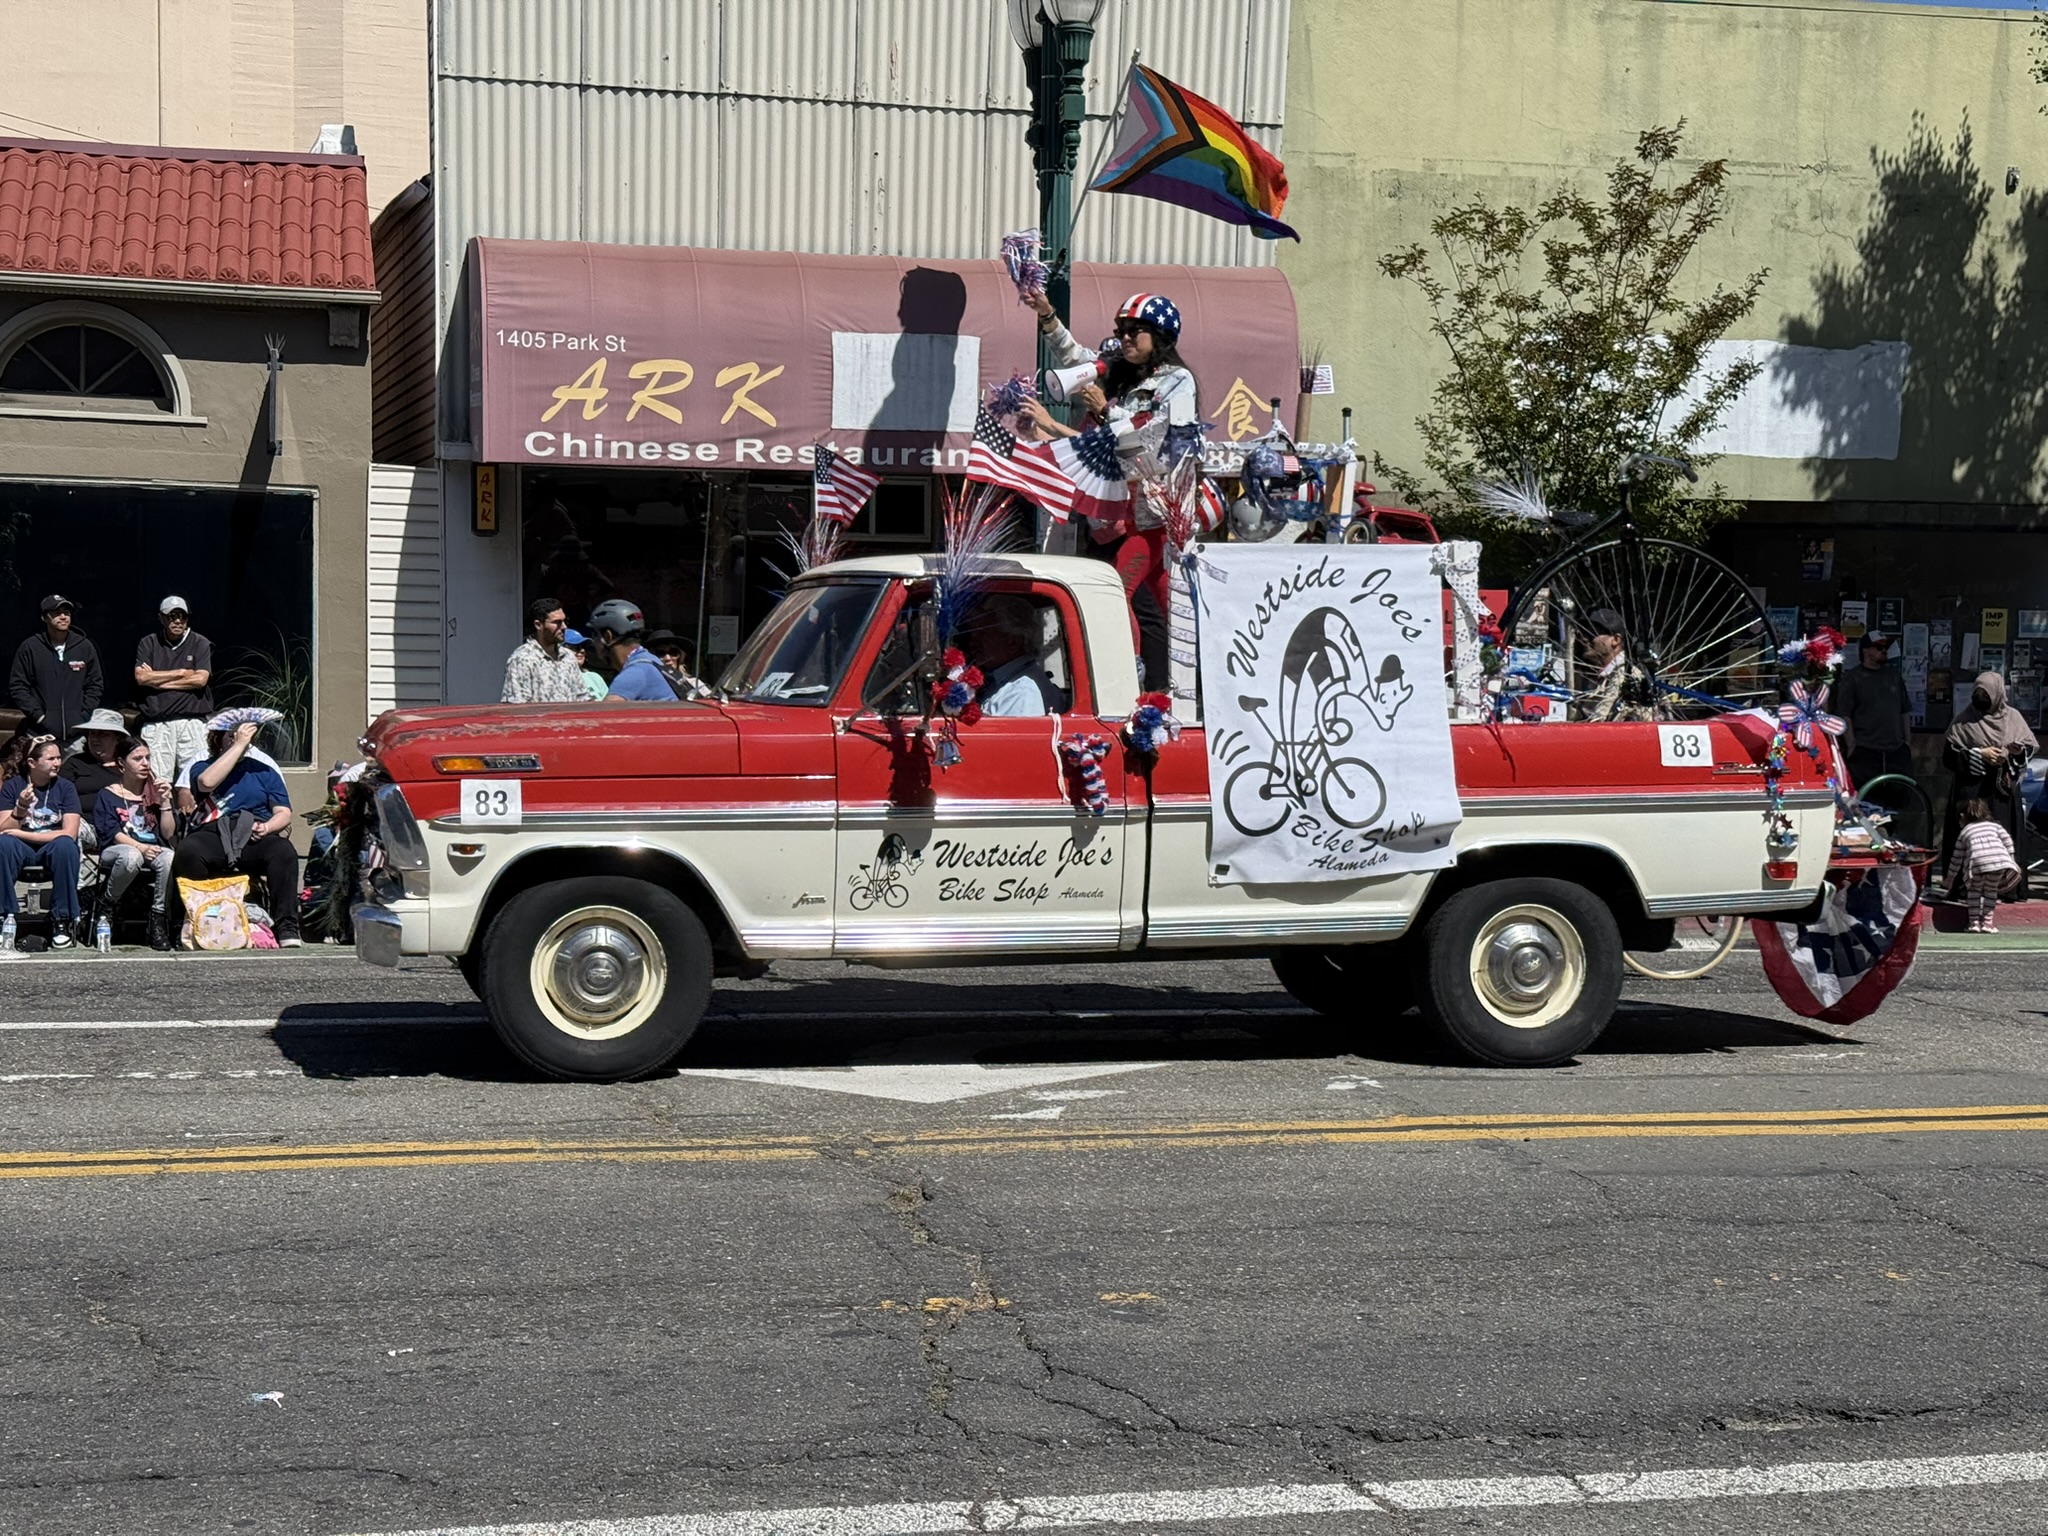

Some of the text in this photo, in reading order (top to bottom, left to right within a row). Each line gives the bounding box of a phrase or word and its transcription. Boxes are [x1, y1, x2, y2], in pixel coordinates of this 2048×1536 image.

[496, 329, 627, 352] 1405 Park St
[541, 357, 785, 428] ARK
[1211, 377, 1272, 441] 食
[524, 431, 970, 467] Chinese Resauran
[480, 473, 493, 523] ARK
[1226, 555, 1432, 678] Westside Joe's
[1444, 609, 1497, 625] Lse
[1985, 612, 2003, 620] IMP
[1673, 734, 1701, 758] 83
[475, 790, 509, 816] 83
[1290, 811, 1426, 854] Bike Shop
[933, 836, 1113, 878] Westside Joe's
[1308, 852, 1390, 871] Alameda
[938, 876, 1050, 906] Bike Shop
[1058, 886, 1105, 899] Alameda
